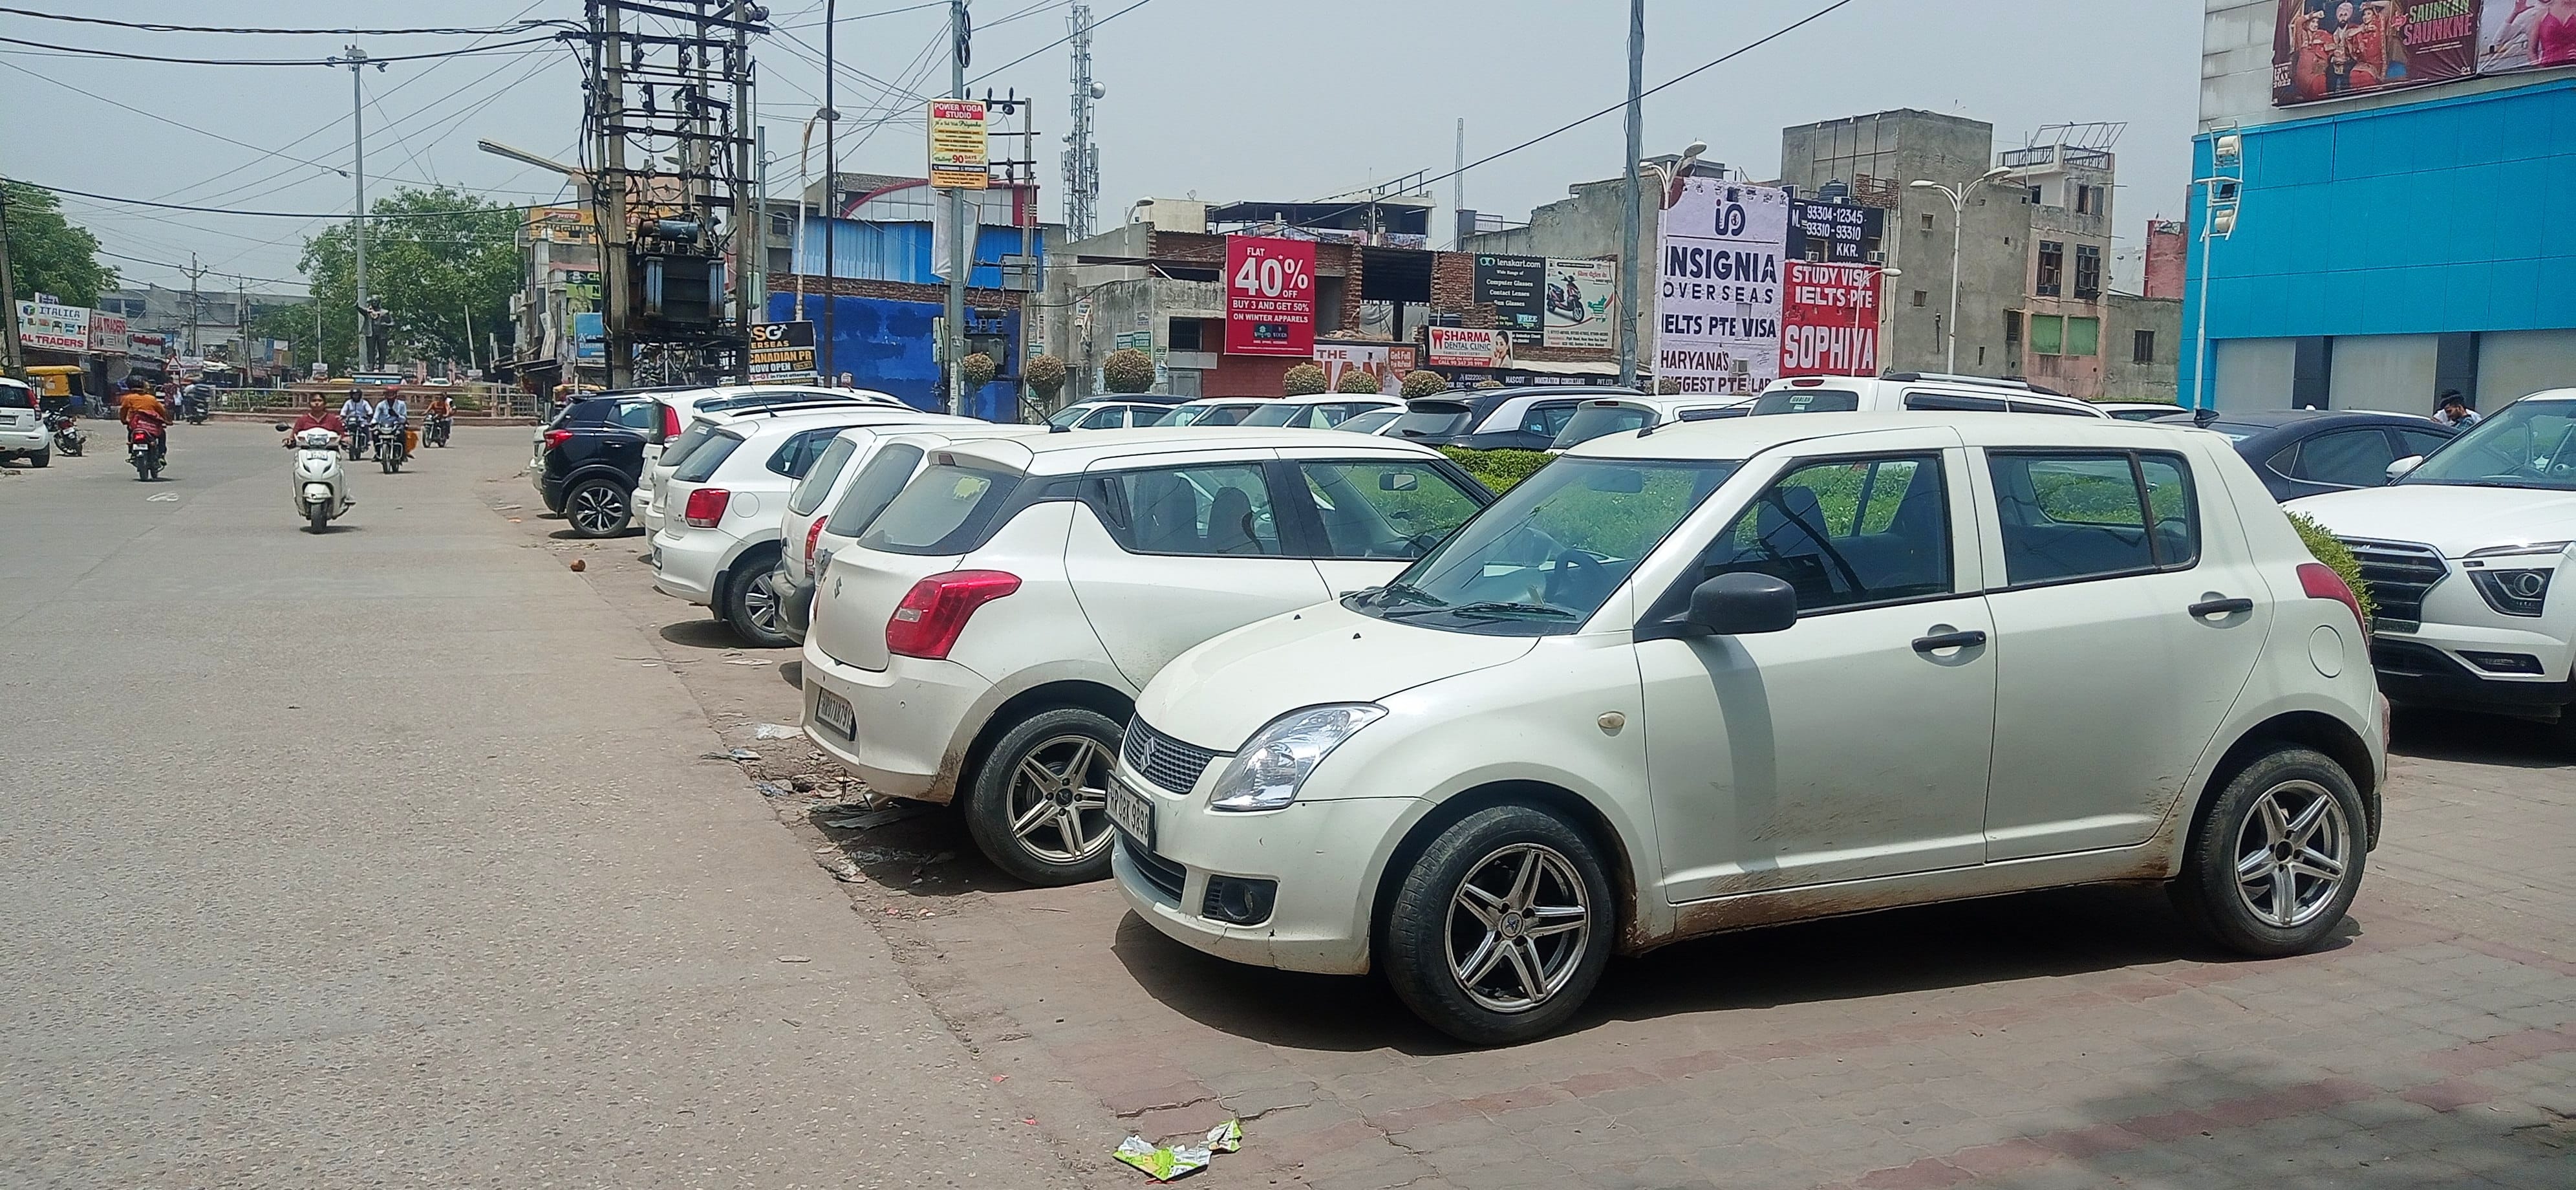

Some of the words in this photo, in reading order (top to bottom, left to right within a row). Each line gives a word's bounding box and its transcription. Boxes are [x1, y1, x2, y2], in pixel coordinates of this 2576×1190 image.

[2403, 13, 2473, 45] SAUNKNE
[2273, 78, 2291, 88] 2022
[952, 155, 963, 163] 90
[1247, 247, 1265, 257] FLAT
[1836, 243, 1859, 257] KKR.
[1497, 258, 1541, 268] lenskart.com
[1664, 245, 1777, 284] INSIGNIA
[1792, 265, 1838, 285] STUDY
[1841, 268, 1870, 287] VISA
[1282, 290, 1298, 298] OFF
[1663, 282, 1774, 304] OVERSEAS
[1795, 285, 1846, 307] IELTS
[1850, 289, 1873, 308] PTE
[1233, 299, 1249, 308] BUY
[1251, 301, 1256, 309] 3
[1258, 301, 1274, 310] AND
[1276, 302, 1292, 311] GET
[1293, 303, 1309, 312] 50%
[39, 307, 81, 319] ITALICA
[1662, 313, 1702, 335] IELTS
[1708, 316, 1737, 336] PTE
[1742, 318, 1777, 338] VISA
[36, 335, 84, 348] TRADERS
[1444, 330, 1491, 342] SHARMA
[1444, 341, 1469, 350] DENTAL
[1783, 325, 1874, 370] SOPHIYA
[750, 352, 797, 363] CANADIAN
[799, 351, 812, 361] PR
[1316, 349, 1347, 359] THE
[1391, 351, 1400, 360] Get
[1661, 350, 1730, 371] HARYANA'S
[749, 363, 769, 373] NOW
[770, 362, 791, 371] OPEN
[1505, 376, 1525, 384] MASCOT
[1718, 376, 1746, 393] PTE
[1110, 786, 1119, 816] HR
